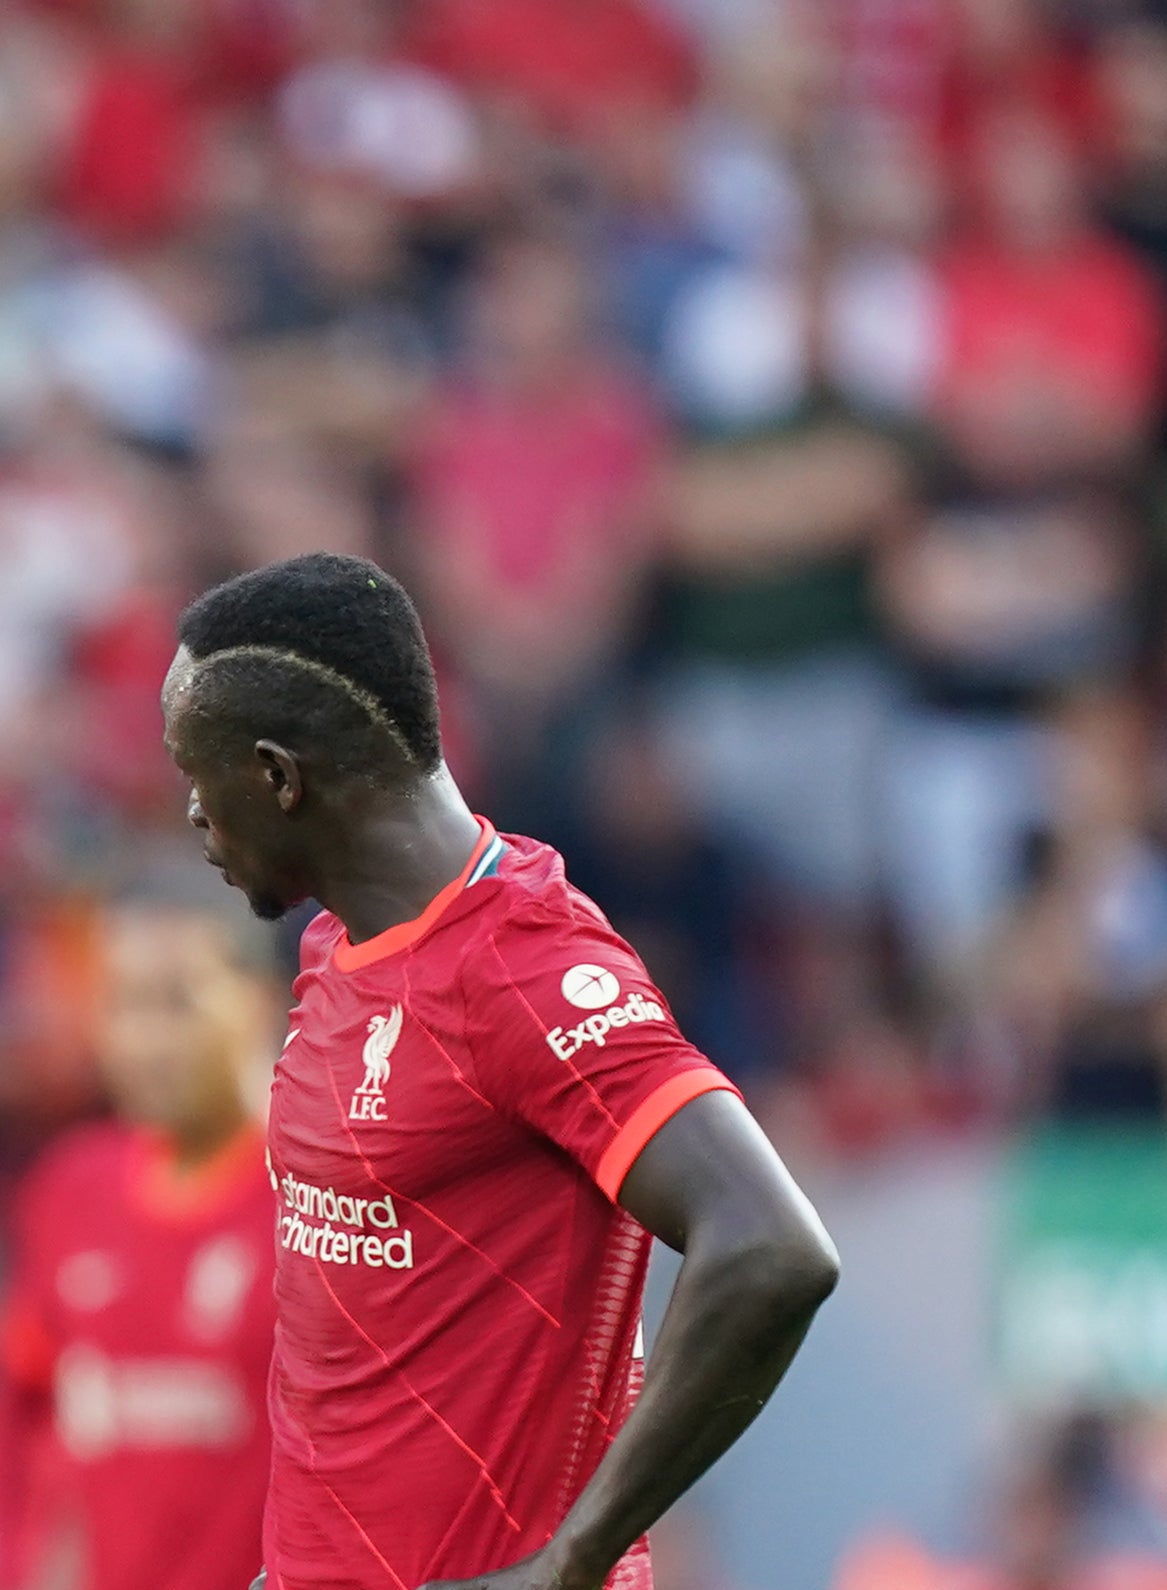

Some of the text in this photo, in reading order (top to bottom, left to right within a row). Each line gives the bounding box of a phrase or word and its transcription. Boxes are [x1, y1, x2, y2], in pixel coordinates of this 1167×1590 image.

[546, 993, 666, 1061] Expedia
[281, 1172, 398, 1229] standard
[281, 1212, 414, 1269] chartered
